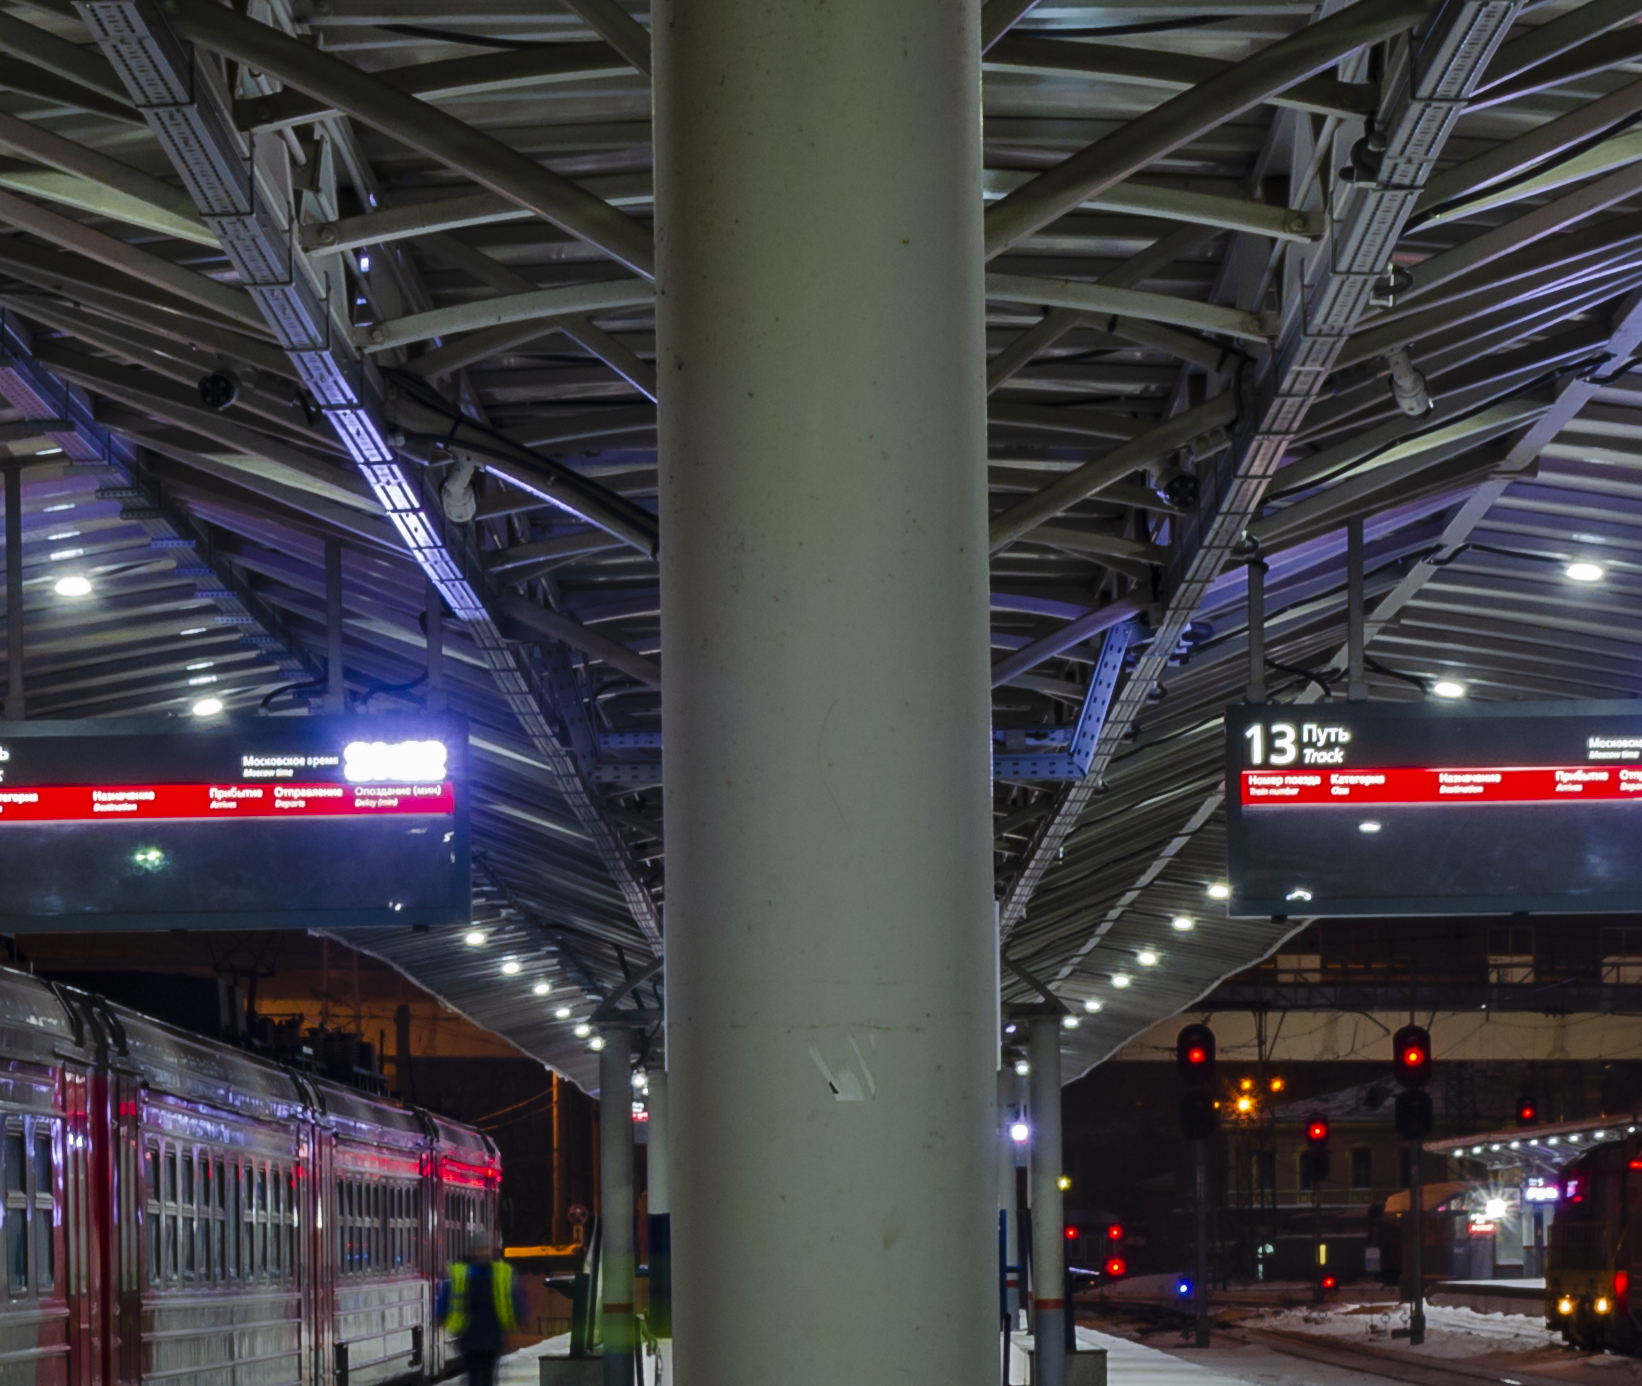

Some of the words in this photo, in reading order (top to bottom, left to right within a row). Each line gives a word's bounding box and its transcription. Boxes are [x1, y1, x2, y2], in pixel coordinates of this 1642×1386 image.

[1302, 725, 1350, 746] Путь
[1245, 724, 1297, 765] 13
[242, 755, 305, 767] Московское
[306, 756, 339, 768] время
[1303, 748, 1345, 764] Track
[1248, 775, 1283, 787] Номер
[1285, 775, 1321, 786] поезда
[1330, 773, 1386, 786] Категория
[1438, 772, 1502, 784] Назначение
[1555, 770, 1609, 782] Прибытие
[92, 790, 155, 802] Назначение
[209, 787, 263, 799] Прибытие
[274, 786, 344, 799] Отправление
[354, 785, 411, 797] Опоздание
